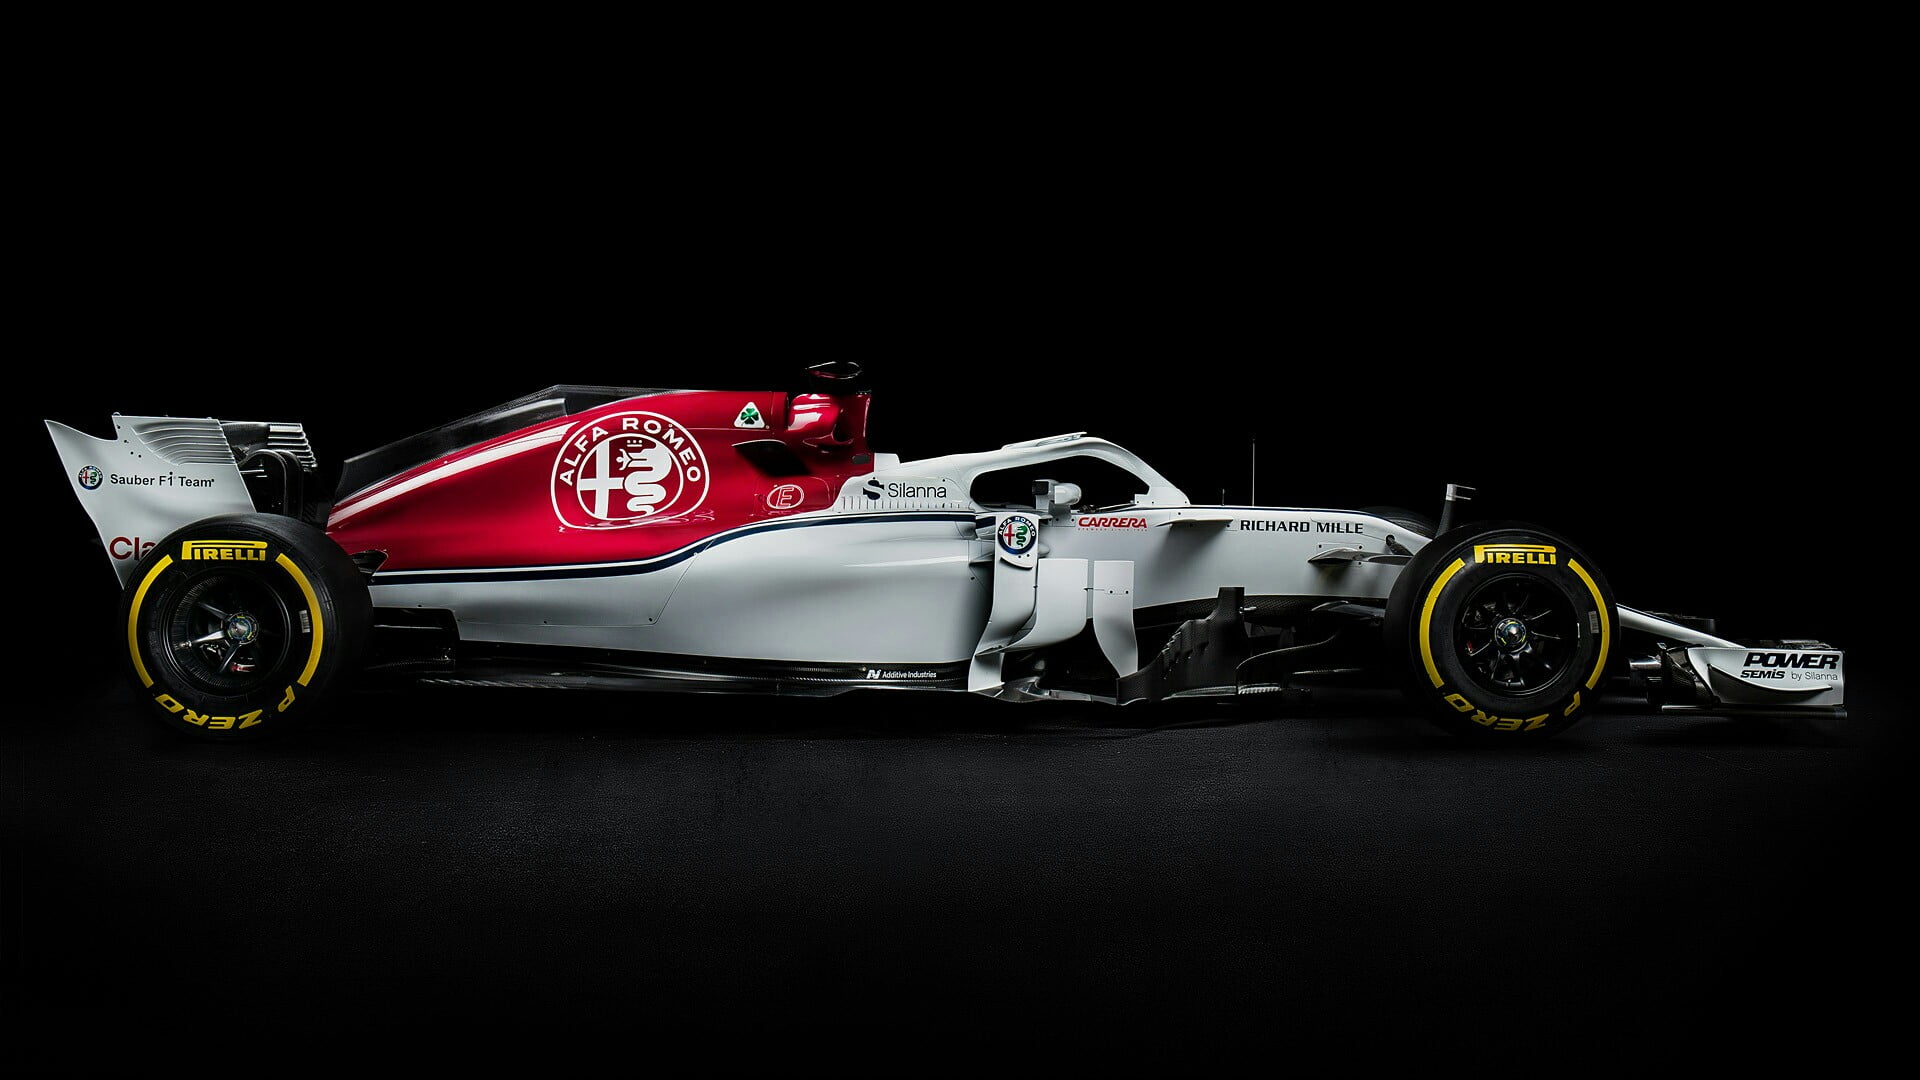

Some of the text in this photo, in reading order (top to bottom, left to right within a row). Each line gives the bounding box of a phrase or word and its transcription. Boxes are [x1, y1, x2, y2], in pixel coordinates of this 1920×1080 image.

[560, 417, 701, 487] ALFA ROMEO
[110, 473, 212, 488] Sauber F1 Team
[888, 483, 947, 499] Silanna
[998, 516, 1036, 537] ALFA ROMEO
[1078, 517, 1148, 529] CARRERA
[1240, 520, 1363, 534] RICHARD MILLE
[181, 540, 268, 561] PIRELLI
[1474, 544, 1557, 565] PIRELLI
[1743, 652, 1840, 669] POWER
[882, 671, 907, 679] Additive
[907, 670, 937, 679] Industries
[1791, 671, 1802, 682] by
[1804, 671, 1838, 681] Silanna
[155, 685, 296, 730] P ZERO
[1444, 691, 1581, 731] P ZERO
